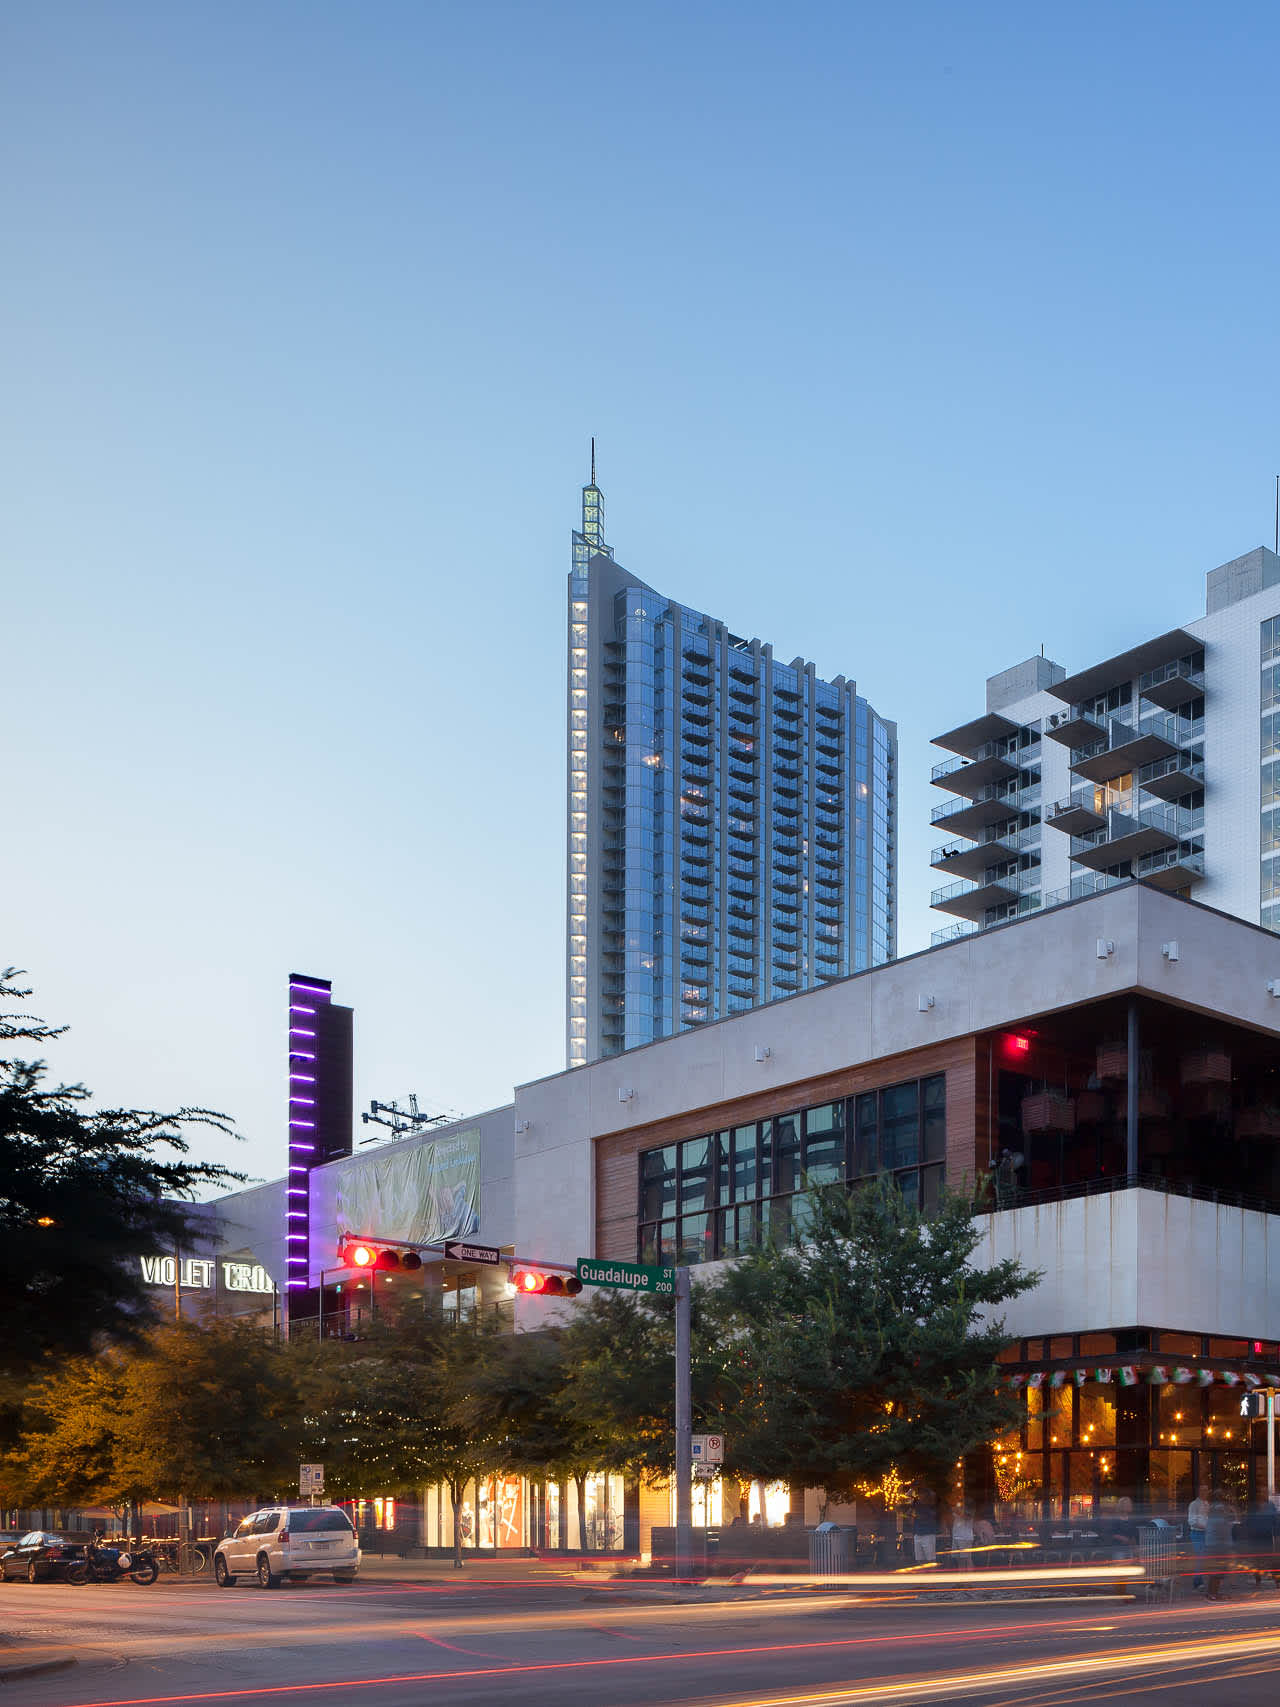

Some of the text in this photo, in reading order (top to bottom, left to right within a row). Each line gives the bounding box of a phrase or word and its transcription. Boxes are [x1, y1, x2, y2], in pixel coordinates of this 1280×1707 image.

[461, 1248, 496, 1261] ONE WAY
[140, 1256, 215, 1288] VIOLET
[580, 1264, 672, 1288] Guadalupe ST
[656, 1282, 672, 1292] 200
